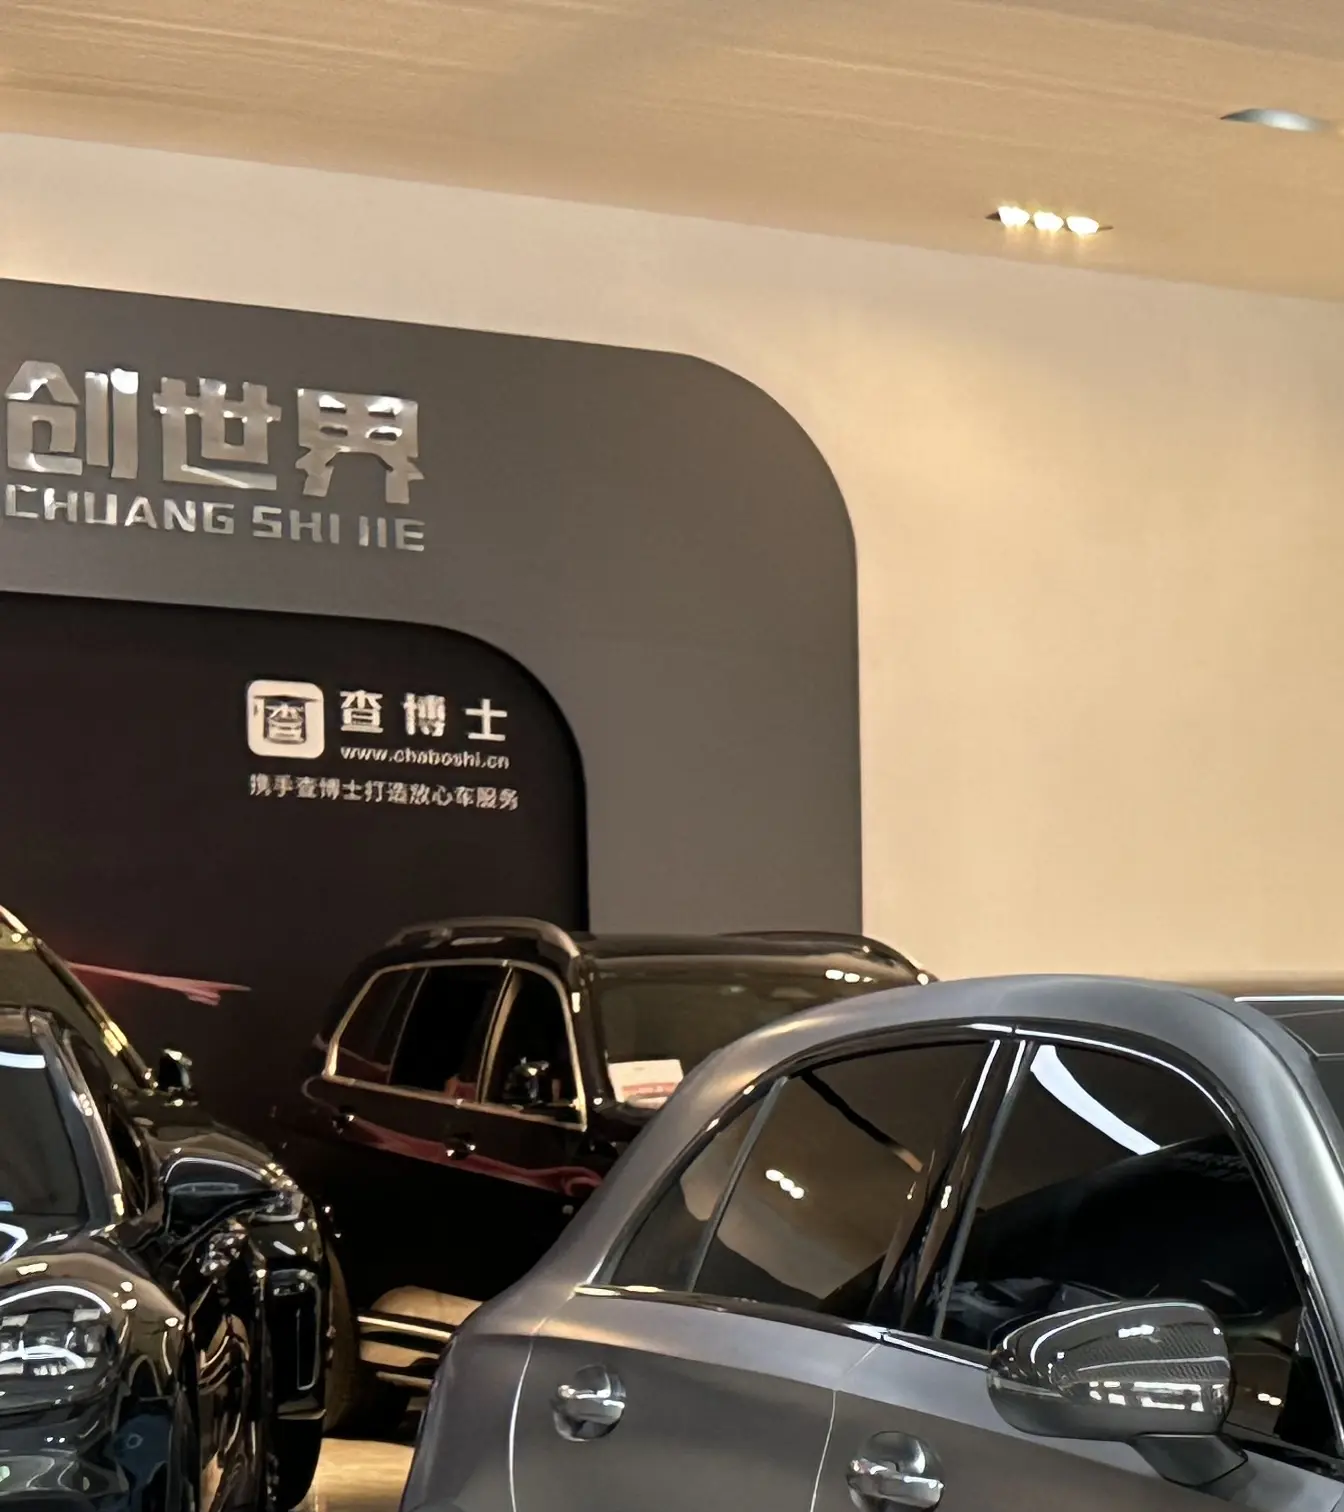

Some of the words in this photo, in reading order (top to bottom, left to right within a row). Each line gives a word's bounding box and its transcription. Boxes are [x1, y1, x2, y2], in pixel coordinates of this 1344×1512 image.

[5, 360, 425, 504] 创世界
[5, 484, 236, 535] CHUANG
[252, 505, 340, 545] SHI
[339, 689, 508, 742] 查博士
